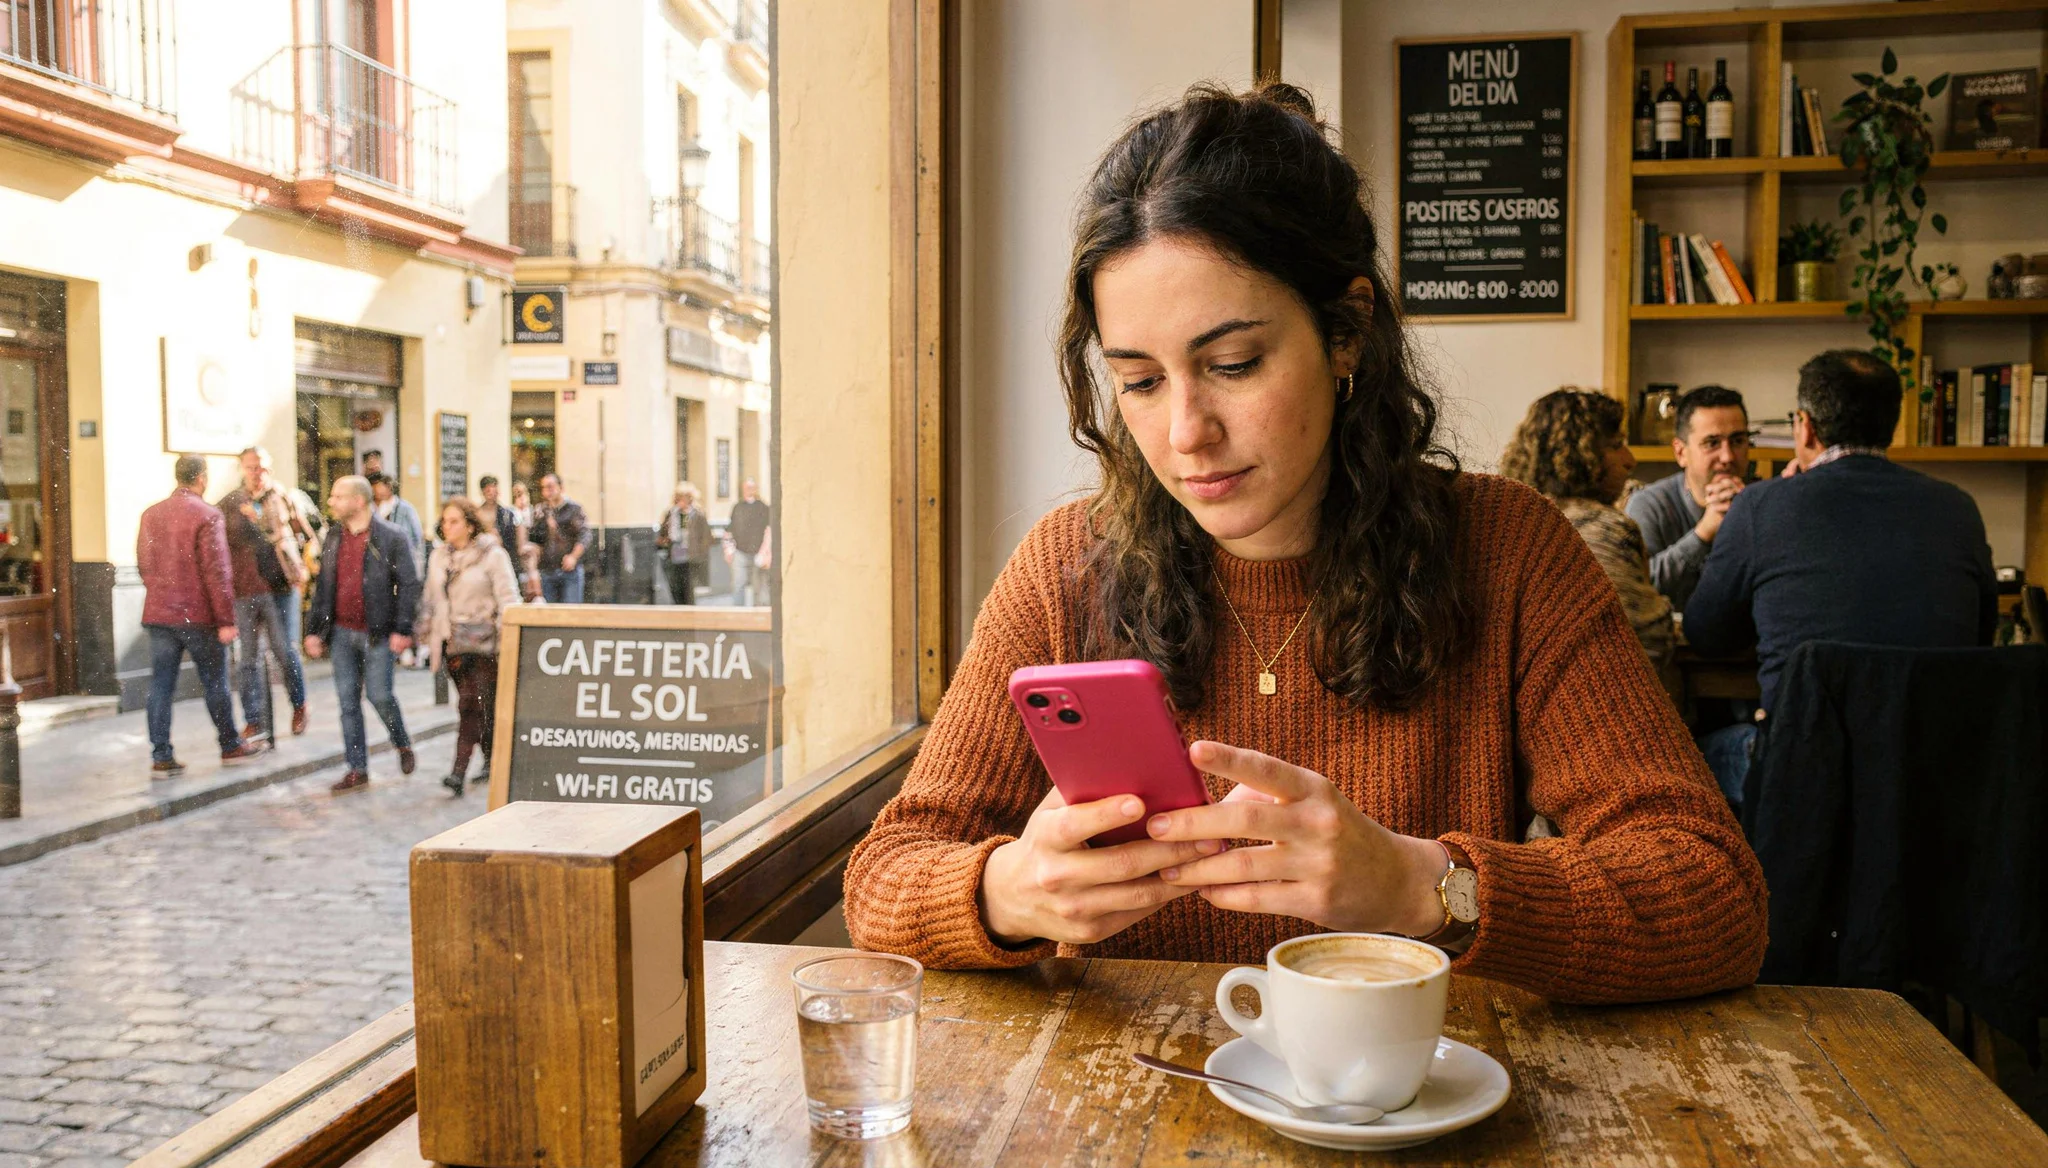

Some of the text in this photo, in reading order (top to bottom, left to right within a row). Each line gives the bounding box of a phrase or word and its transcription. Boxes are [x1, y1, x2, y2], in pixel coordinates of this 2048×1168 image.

[1449, 82, 1484, 106] DEL
[522, 293, 555, 333] C
[537, 633, 752, 680] CAFETERÍA
[576, 682, 708, 722] EL SOL
[644, 731, 750, 754] MERIENDAS
[555, 773, 713, 804] WI-FI GRATIS
